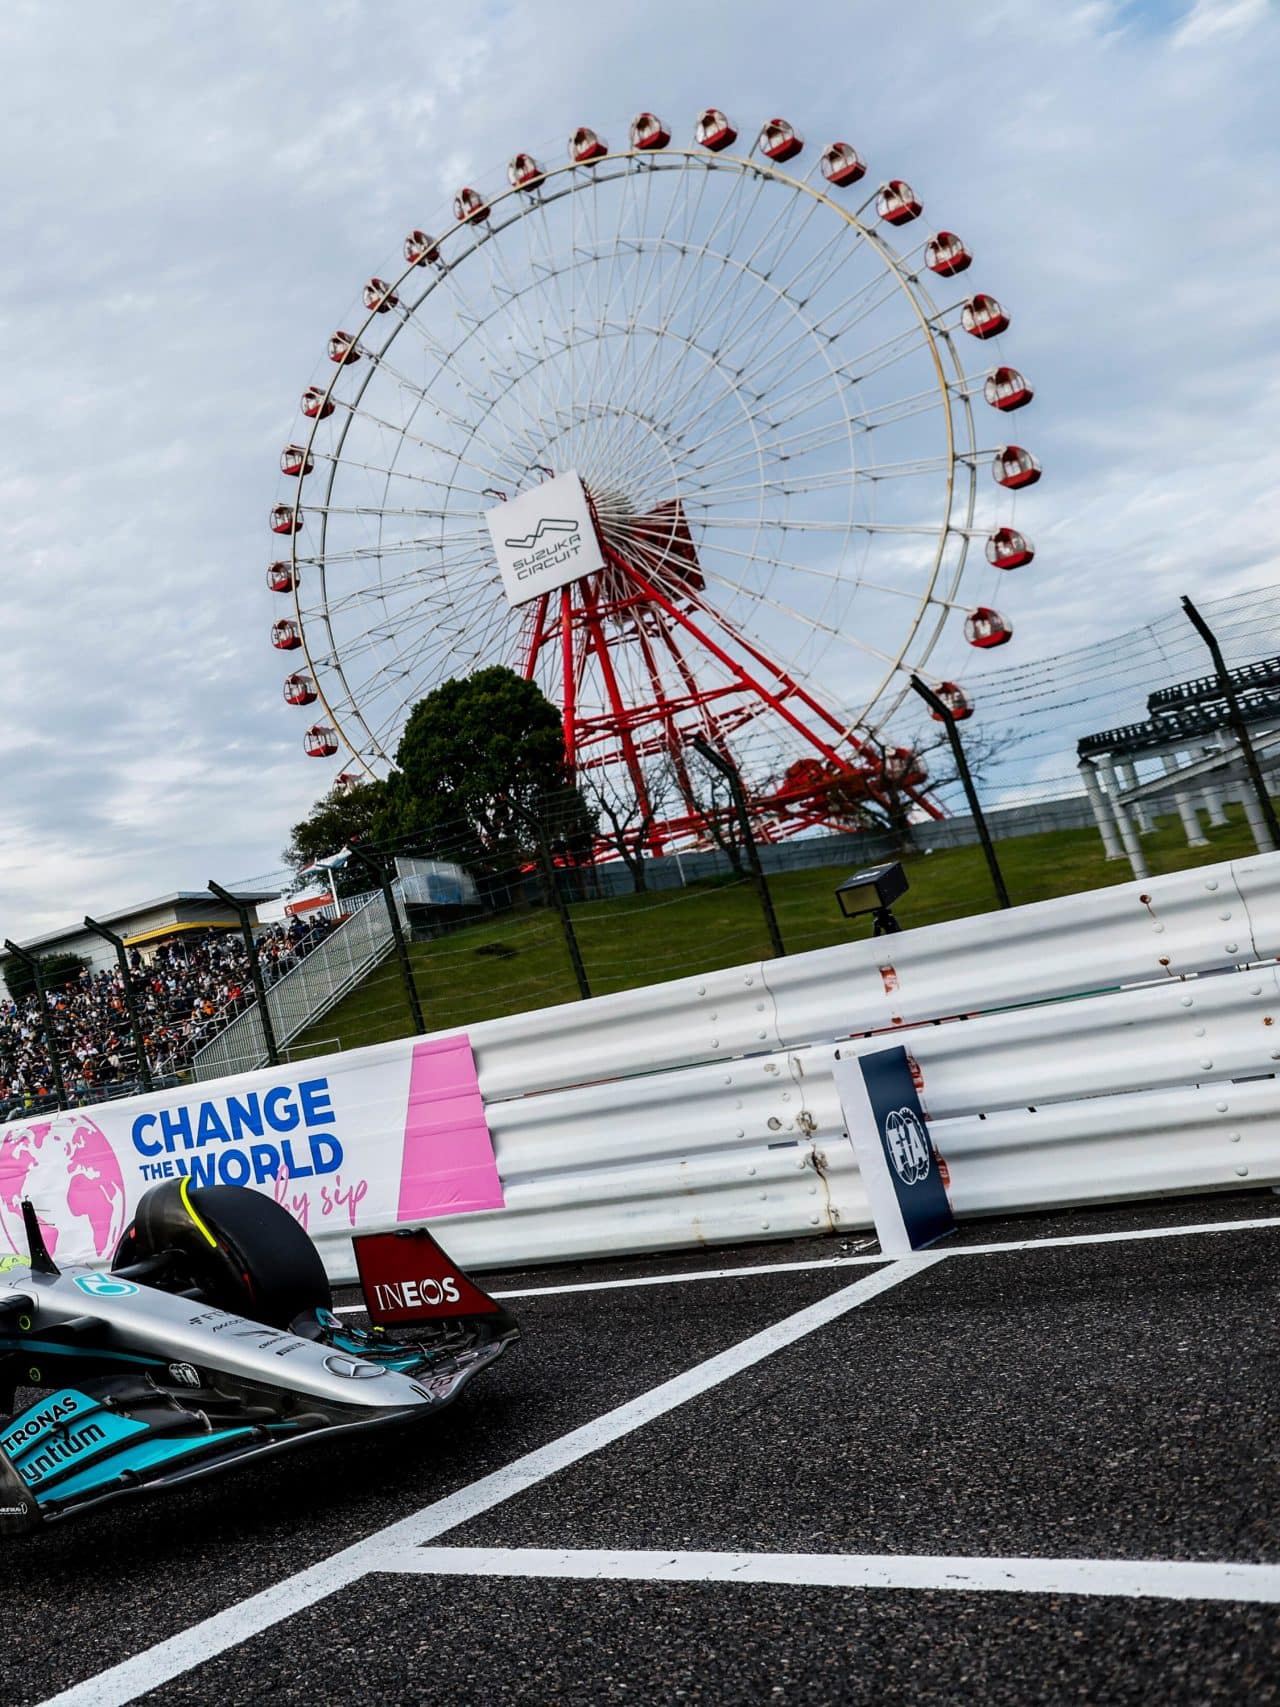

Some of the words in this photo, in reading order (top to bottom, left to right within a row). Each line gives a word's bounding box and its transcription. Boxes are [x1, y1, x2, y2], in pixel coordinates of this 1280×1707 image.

[512, 533, 582, 571] SUZUKA
[516, 544, 582, 581] CIRCUIT
[131, 1077, 336, 1157] CHANGE
[139, 1160, 174, 1181] THE
[175, 1133, 344, 1190] WORLD
[887, 1118, 929, 1173] FIA
[320, 1174, 368, 1227] sip
[374, 1277, 460, 1311] INEOS
